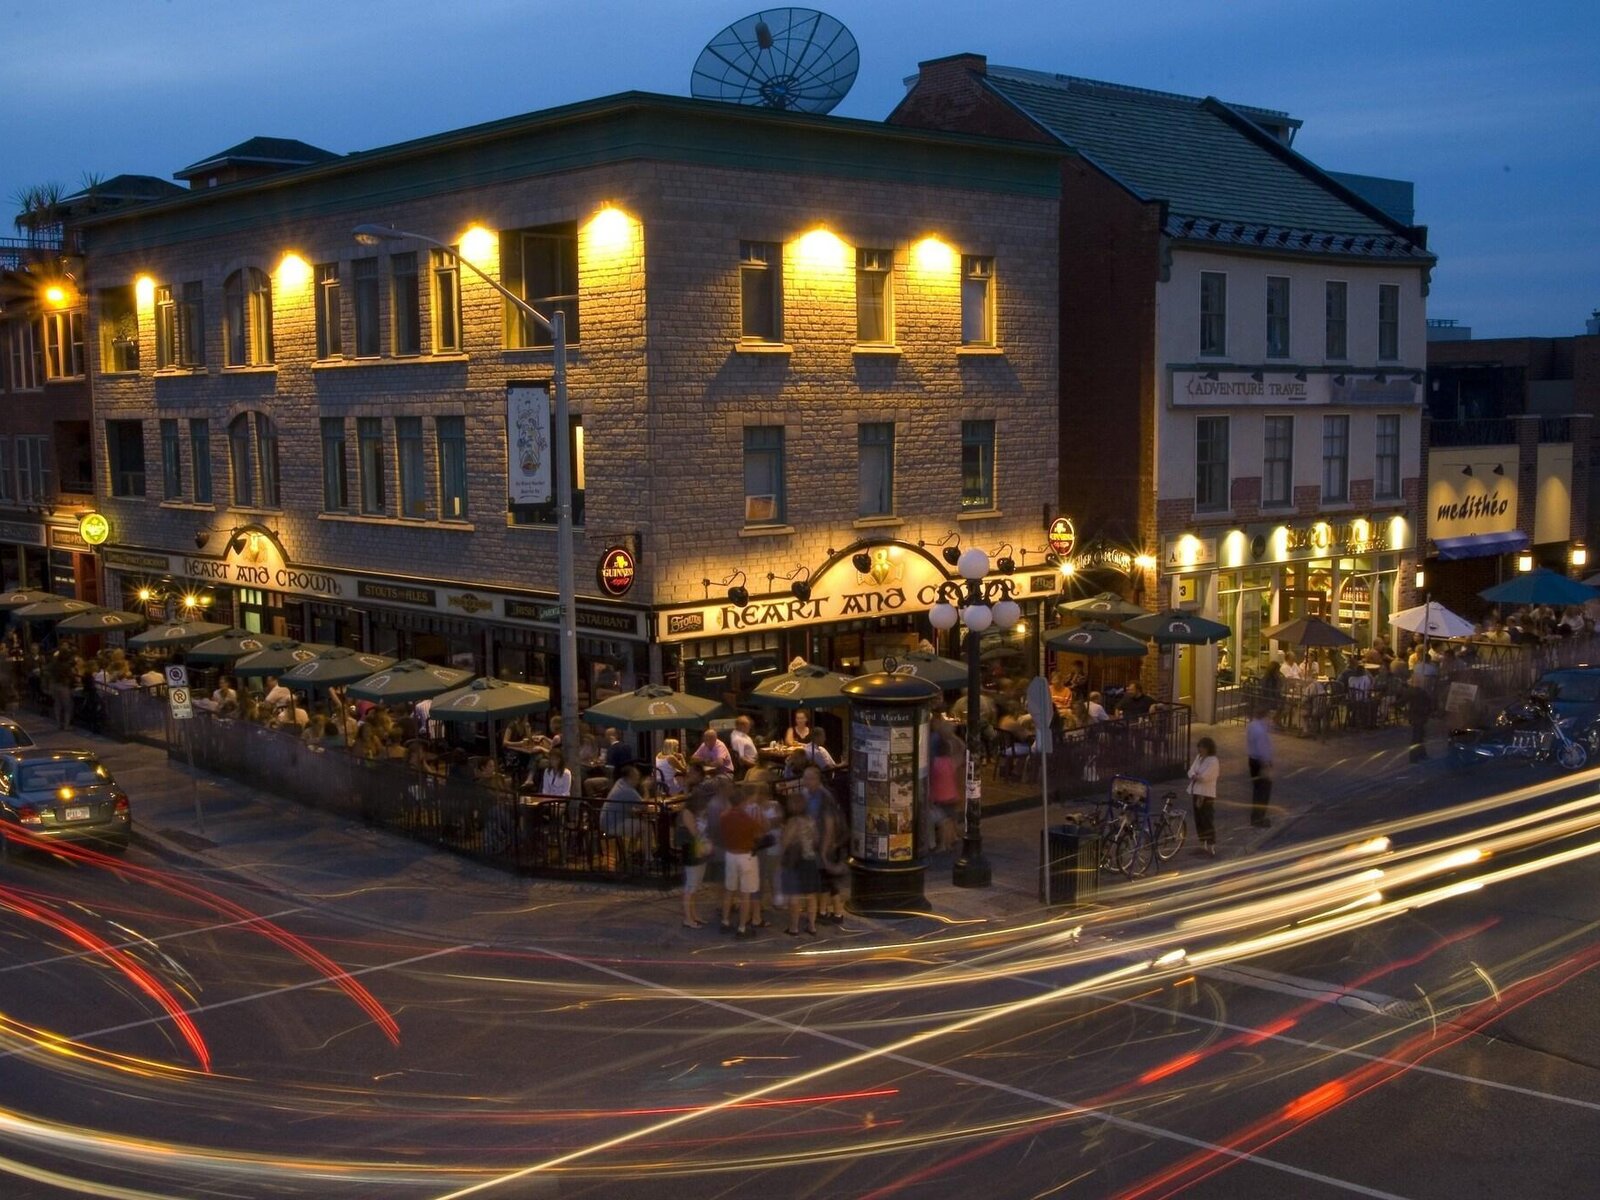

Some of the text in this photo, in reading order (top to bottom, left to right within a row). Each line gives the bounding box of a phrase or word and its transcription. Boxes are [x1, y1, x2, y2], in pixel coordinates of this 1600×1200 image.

[1195, 382, 1307, 395] ADVENTURE TRAVEL
[1437, 491, 1509, 521] medithéo
[364, 584, 397, 599] STOUTS
[880, 711, 909, 721] Market
